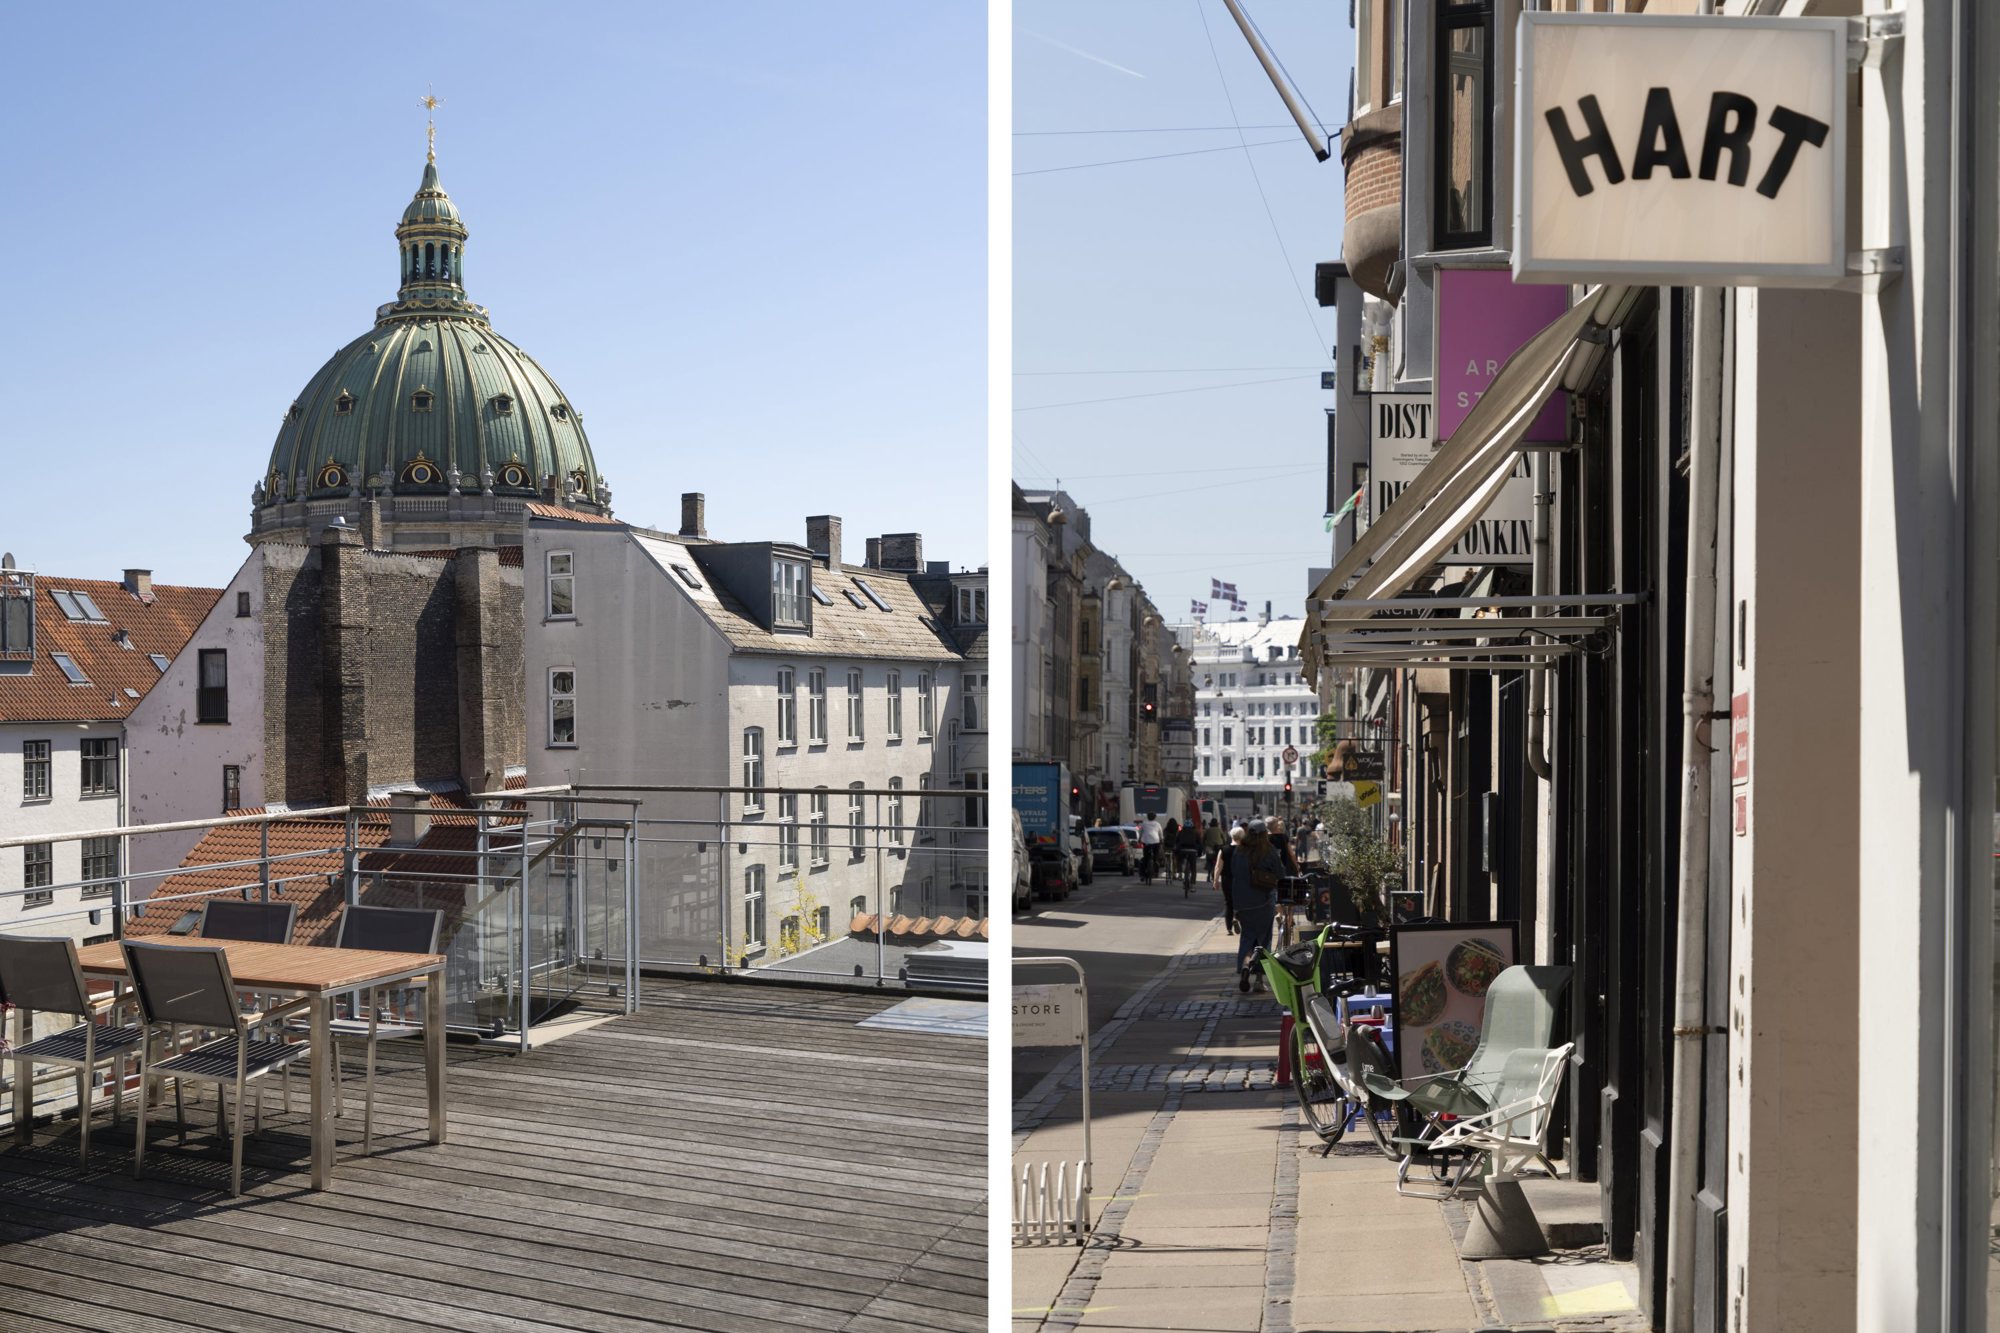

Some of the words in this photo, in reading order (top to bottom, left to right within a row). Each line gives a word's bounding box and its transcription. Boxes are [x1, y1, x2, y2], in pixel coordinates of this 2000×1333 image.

[1545, 87, 1830, 199] HART
[1378, 403, 1431, 439] DIST
[1378, 480, 1410, 516] DI
[1375, 607, 1421, 615] NCHY
[1012, 1004, 1061, 1015] STORE
